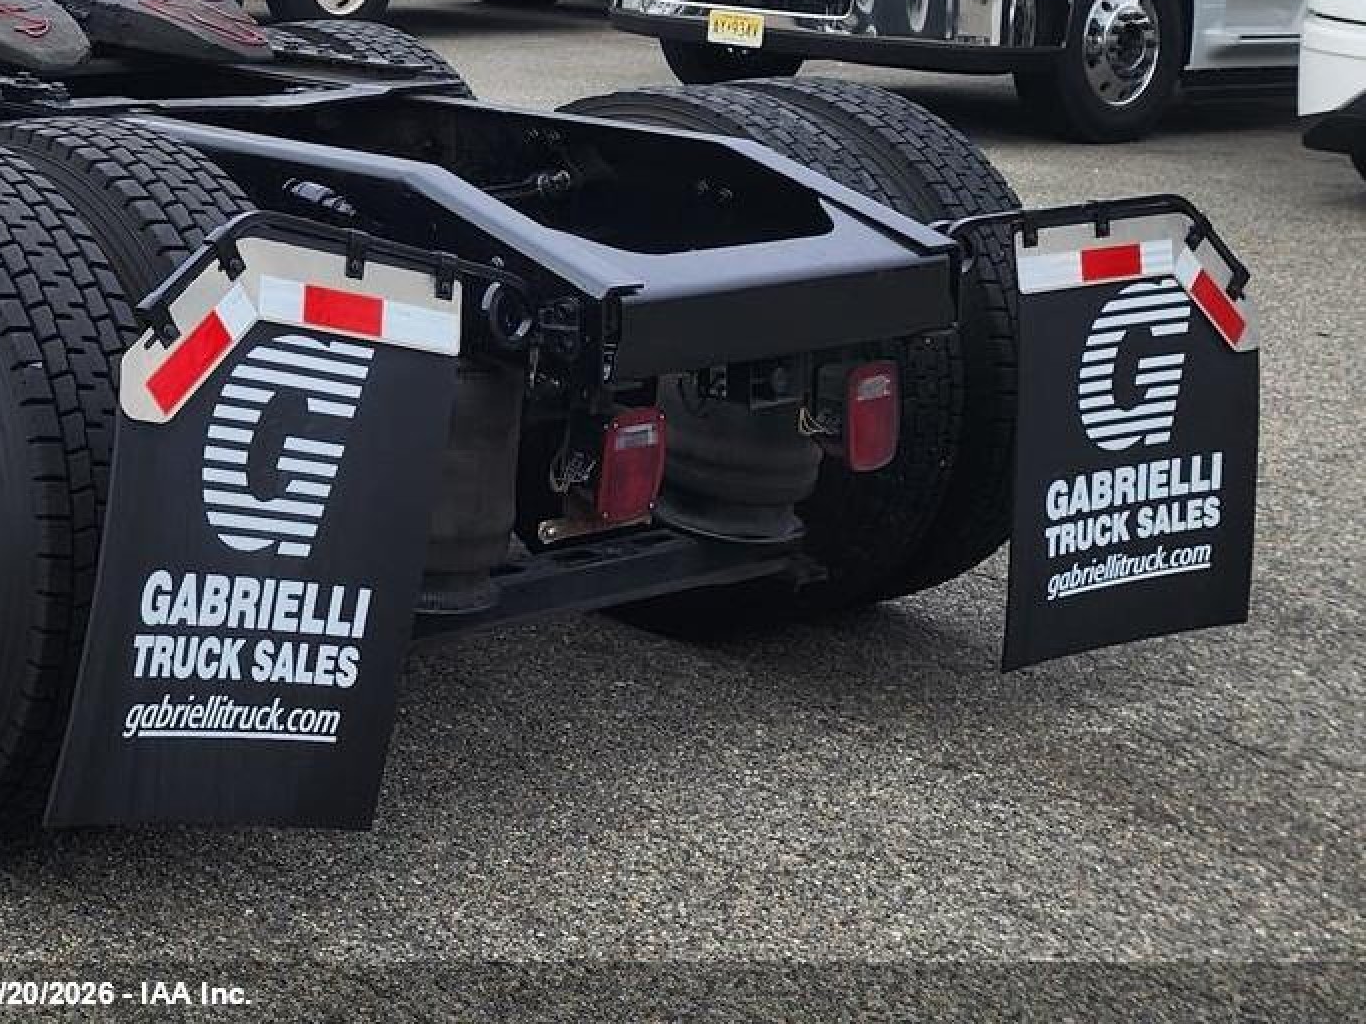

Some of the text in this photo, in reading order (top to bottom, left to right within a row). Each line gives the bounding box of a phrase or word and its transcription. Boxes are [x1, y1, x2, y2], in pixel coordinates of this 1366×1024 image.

[1079, 278, 1192, 452] G
[201, 334, 375, 559] G
[1046, 451, 1224, 521] GABRIELLI
[1045, 495, 1221, 559] TRUCK SALES
[141, 569, 372, 639] GABRIELLI
[1047, 542, 1212, 602] gabriellitruck.com
[133, 635, 360, 689] TRUCK SALES
[123, 693, 342, 744] gabriellitruck.com
